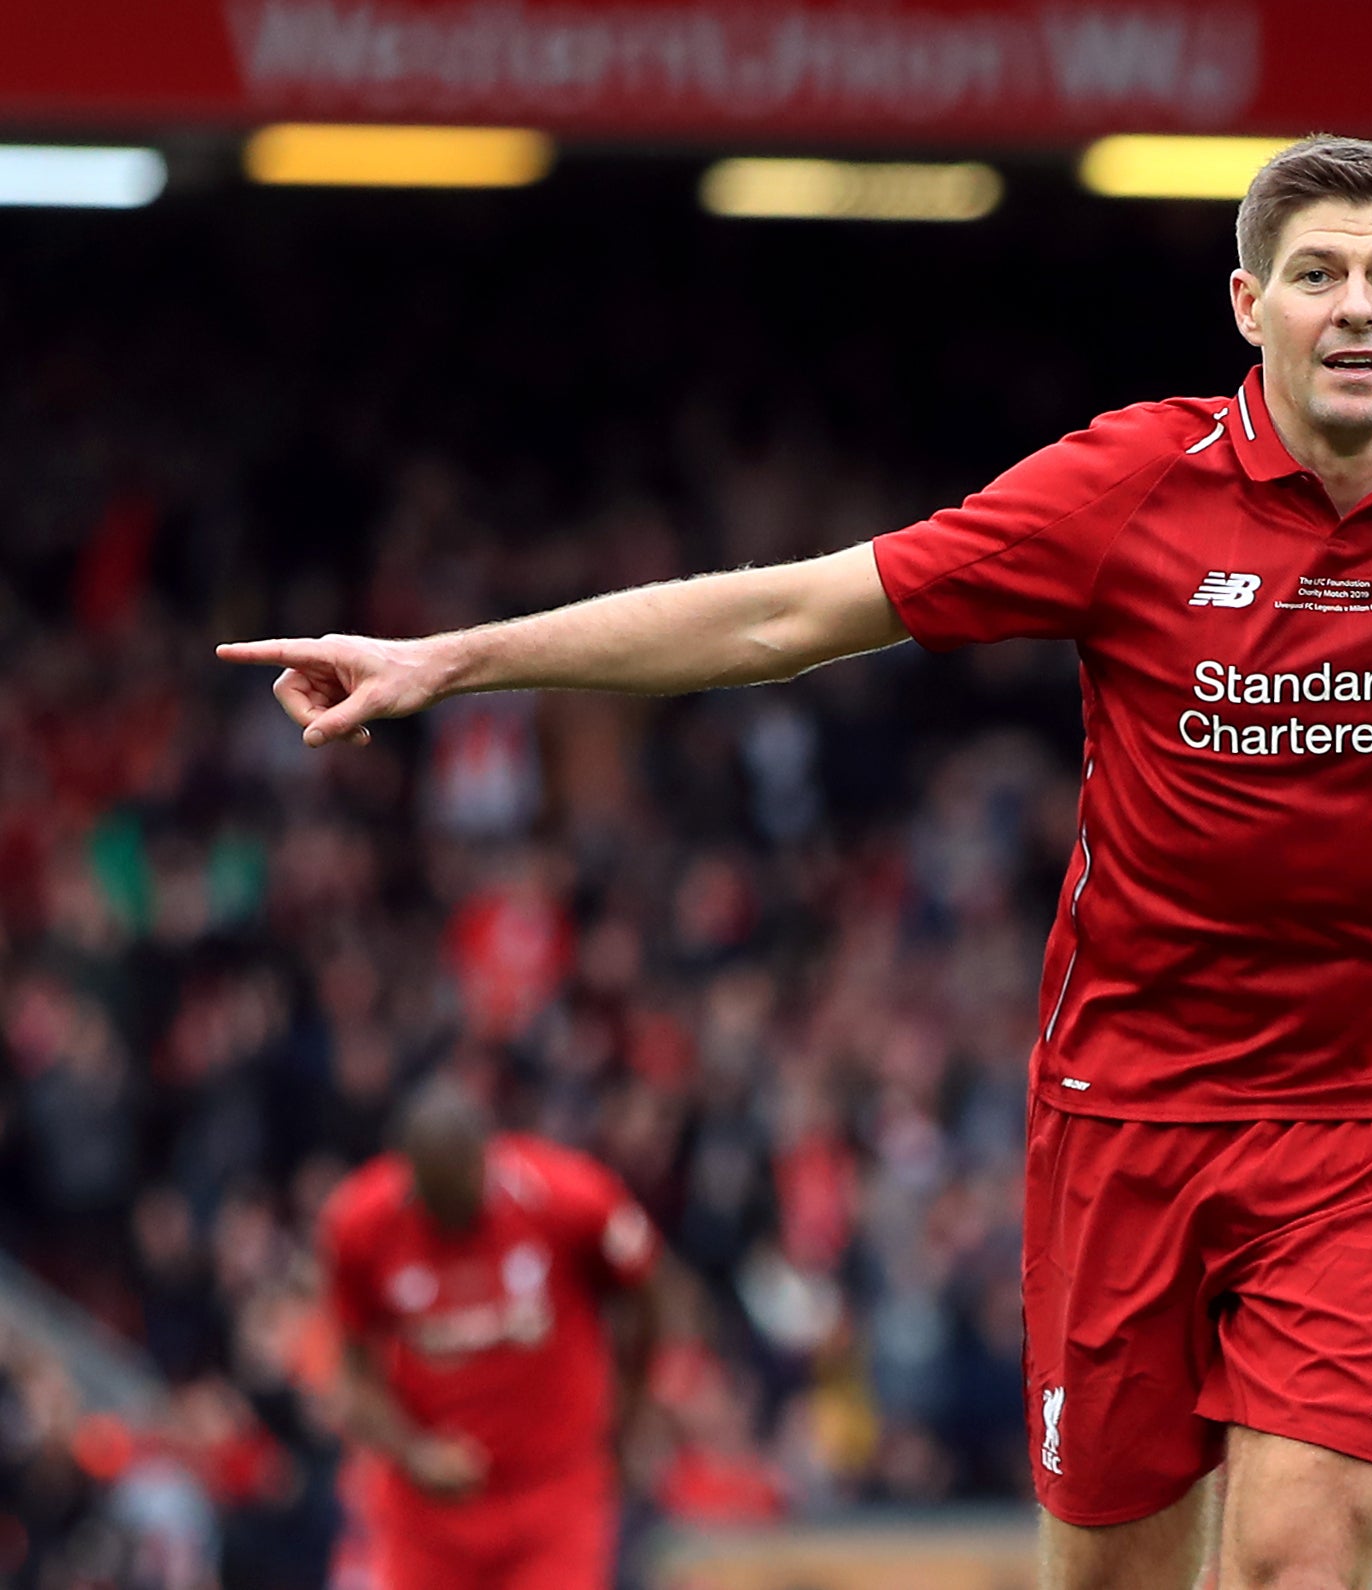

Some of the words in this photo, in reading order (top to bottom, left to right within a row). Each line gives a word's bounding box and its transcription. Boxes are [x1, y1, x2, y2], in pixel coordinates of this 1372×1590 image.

[1299, 576, 1312, 585] The
[1313, 578, 1326, 586] LFC
[1326, 578, 1371, 588] Foundation
[1298, 587, 1322, 598] Charity
[1323, 589, 1349, 598] Match
[1350, 590, 1369, 599] 2019
[1274, 600, 1304, 609] Liverpool
[1305, 602, 1313, 611] FC
[1314, 603, 1343, 613] Legends
